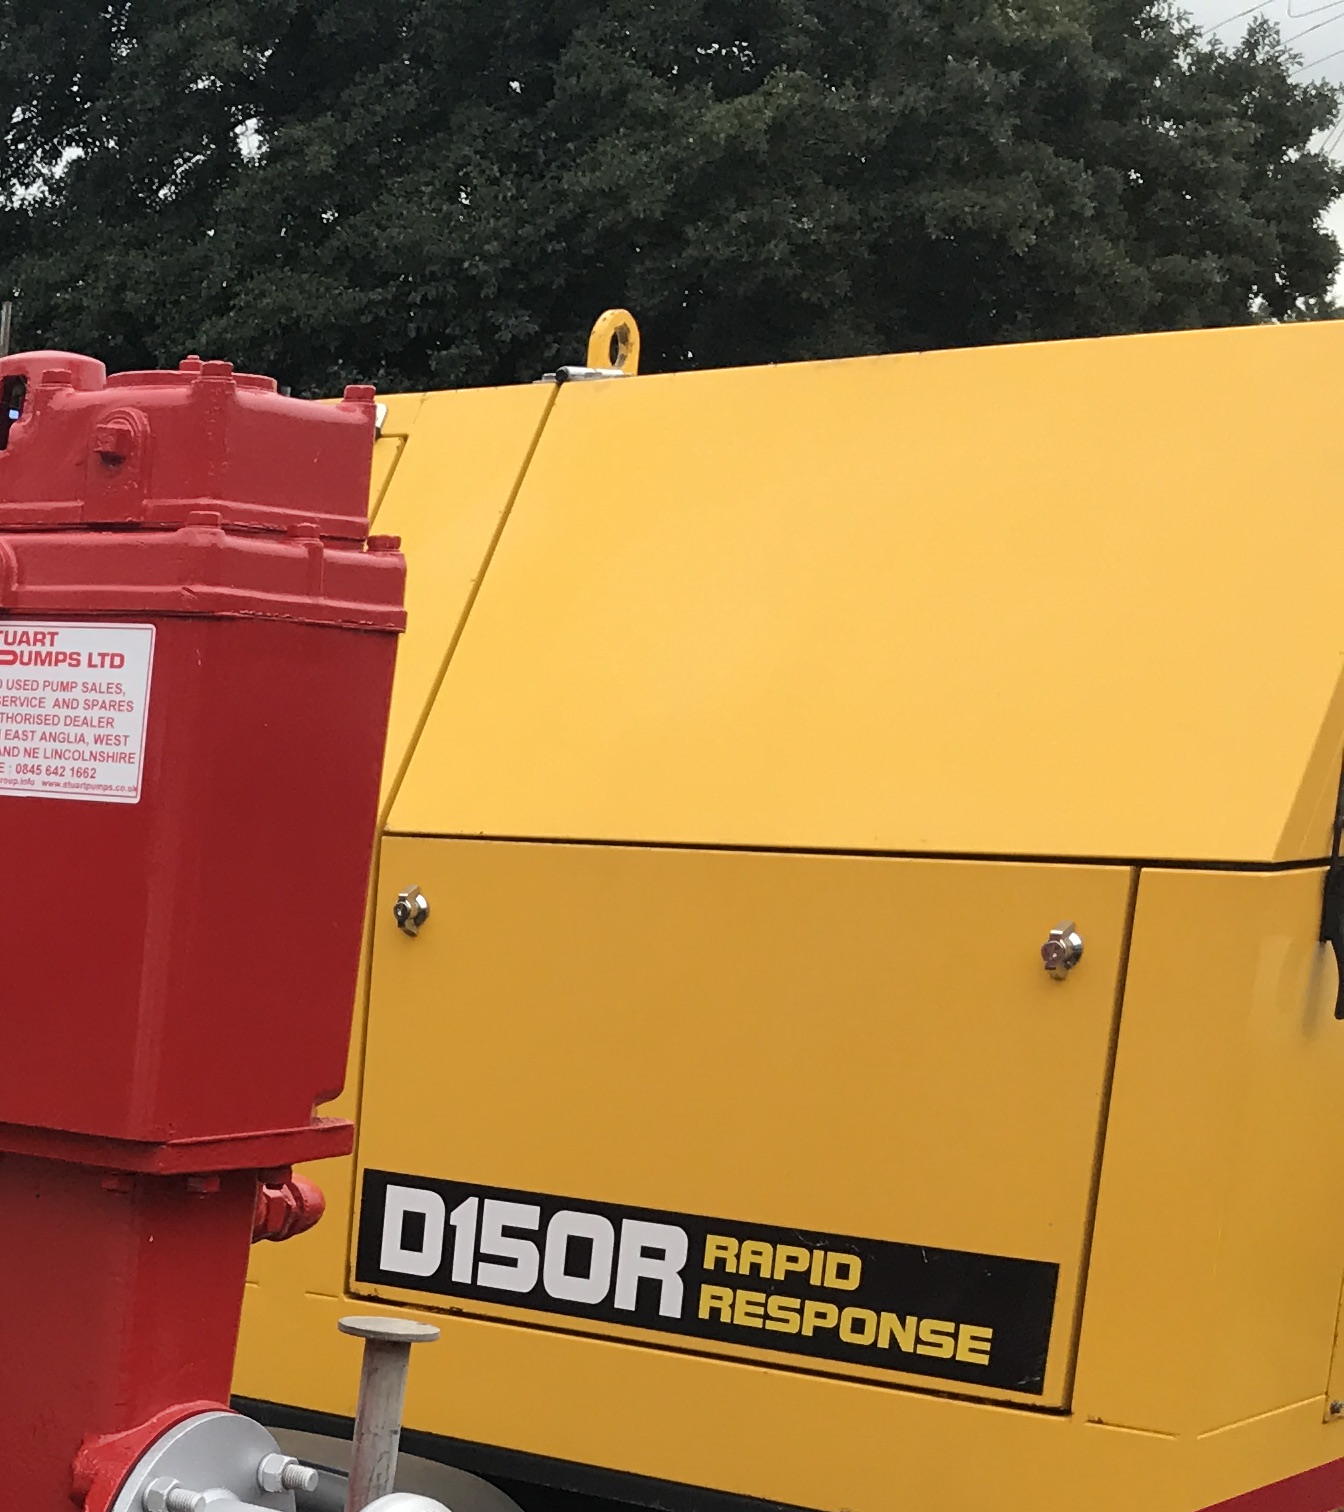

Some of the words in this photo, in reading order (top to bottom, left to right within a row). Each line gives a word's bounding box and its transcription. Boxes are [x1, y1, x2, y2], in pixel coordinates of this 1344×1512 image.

[86, 652, 125, 669] LTD
[6, 678, 39, 691] USED
[42, 680, 78, 693] PUMP
[81, 681, 126, 697] SALES,
[52, 696, 79, 710] AND
[82, 698, 134, 712] SPARES
[64, 715, 115, 729] DEALER
[4, 728, 37, 741] EAST
[39, 730, 89, 746] ANGLIA,
[93, 733, 130, 746] WEST
[23, 746, 39, 759] NE
[43, 748, 136, 764] LINCOLNSHIRE
[15, 762, 42, 776] 0845
[45, 764, 66, 777] 642
[70, 766, 97, 779] 1662
[379, 1183, 688, 1319] D150R
[703, 1234, 862, 1291] RAPID
[698, 1283, 993, 1366] RESPONSE
